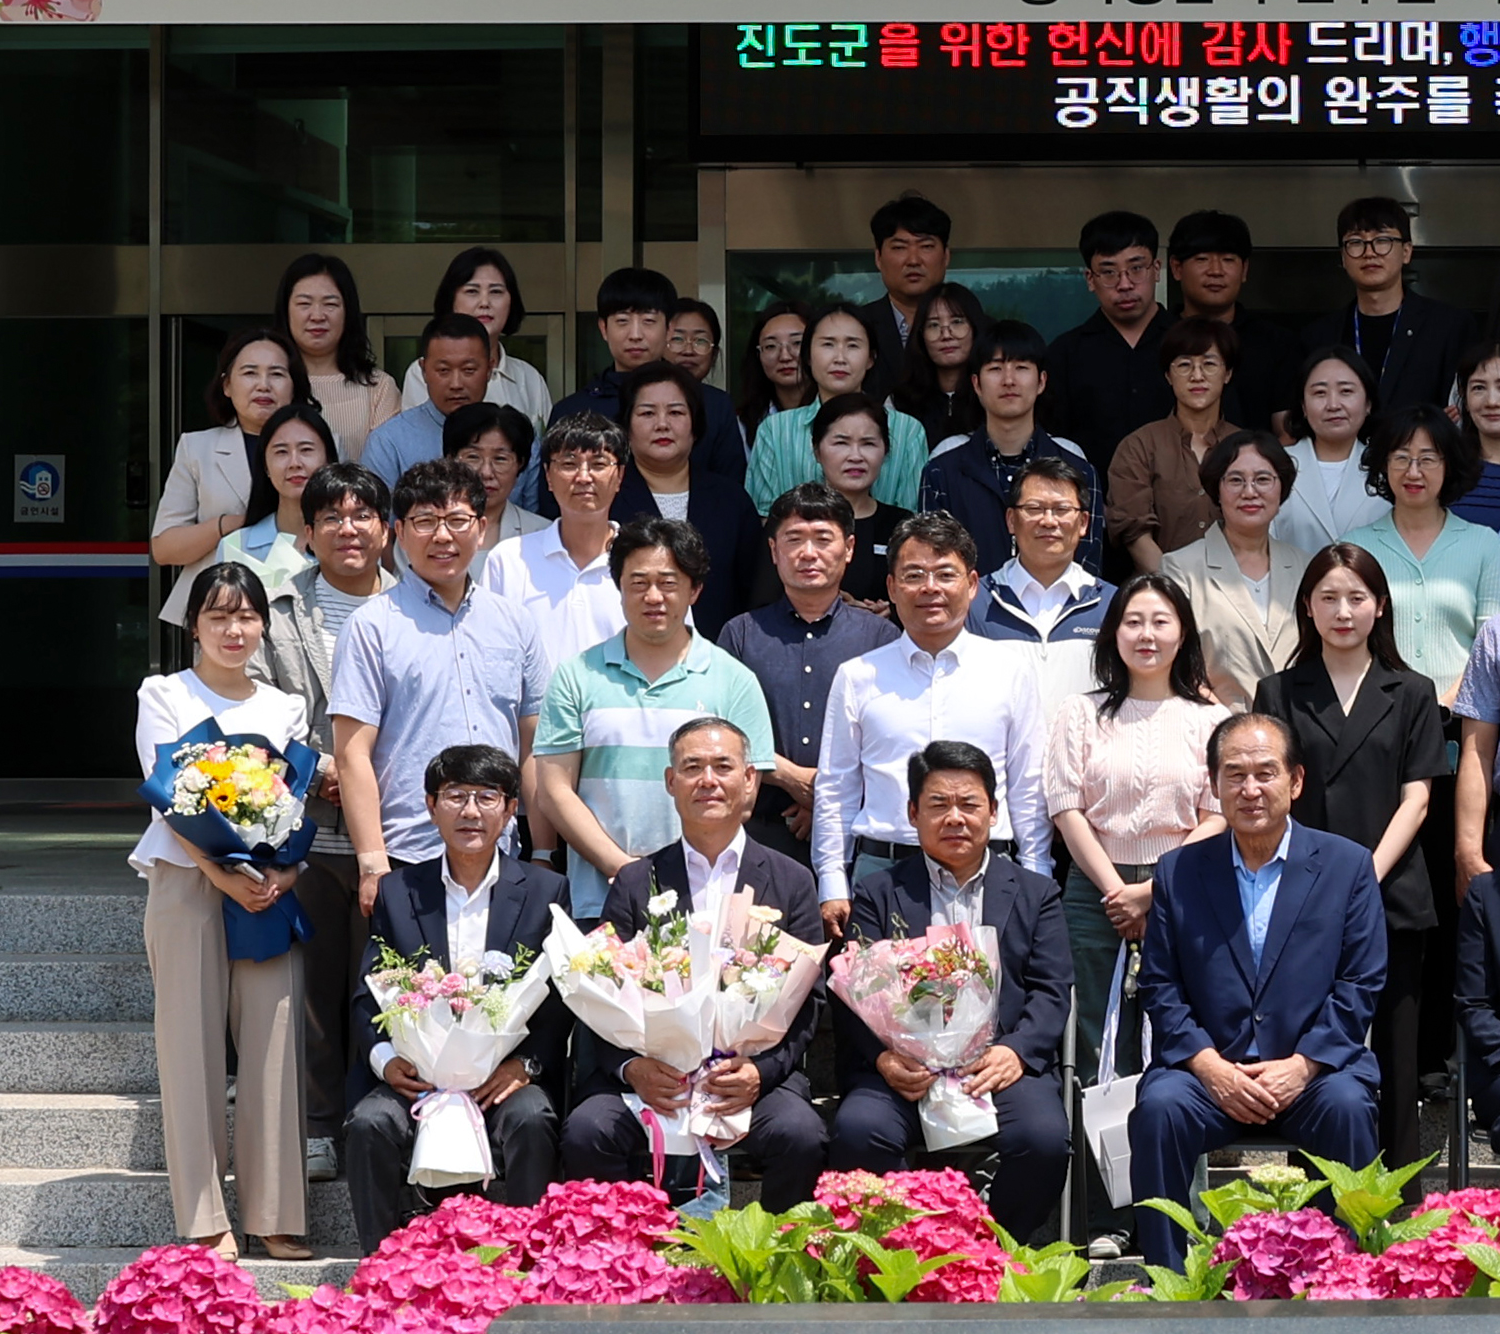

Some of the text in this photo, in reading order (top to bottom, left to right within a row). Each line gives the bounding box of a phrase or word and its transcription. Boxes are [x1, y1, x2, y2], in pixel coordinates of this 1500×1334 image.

[940, 21, 1030, 67] 위한
[1048, 21, 1182, 67] 헌신에
[1055, 74, 1300, 127] 공직생활의
[1325, 74, 1472, 125] 완주를
[20, 506, 60, 516] 금연시설
